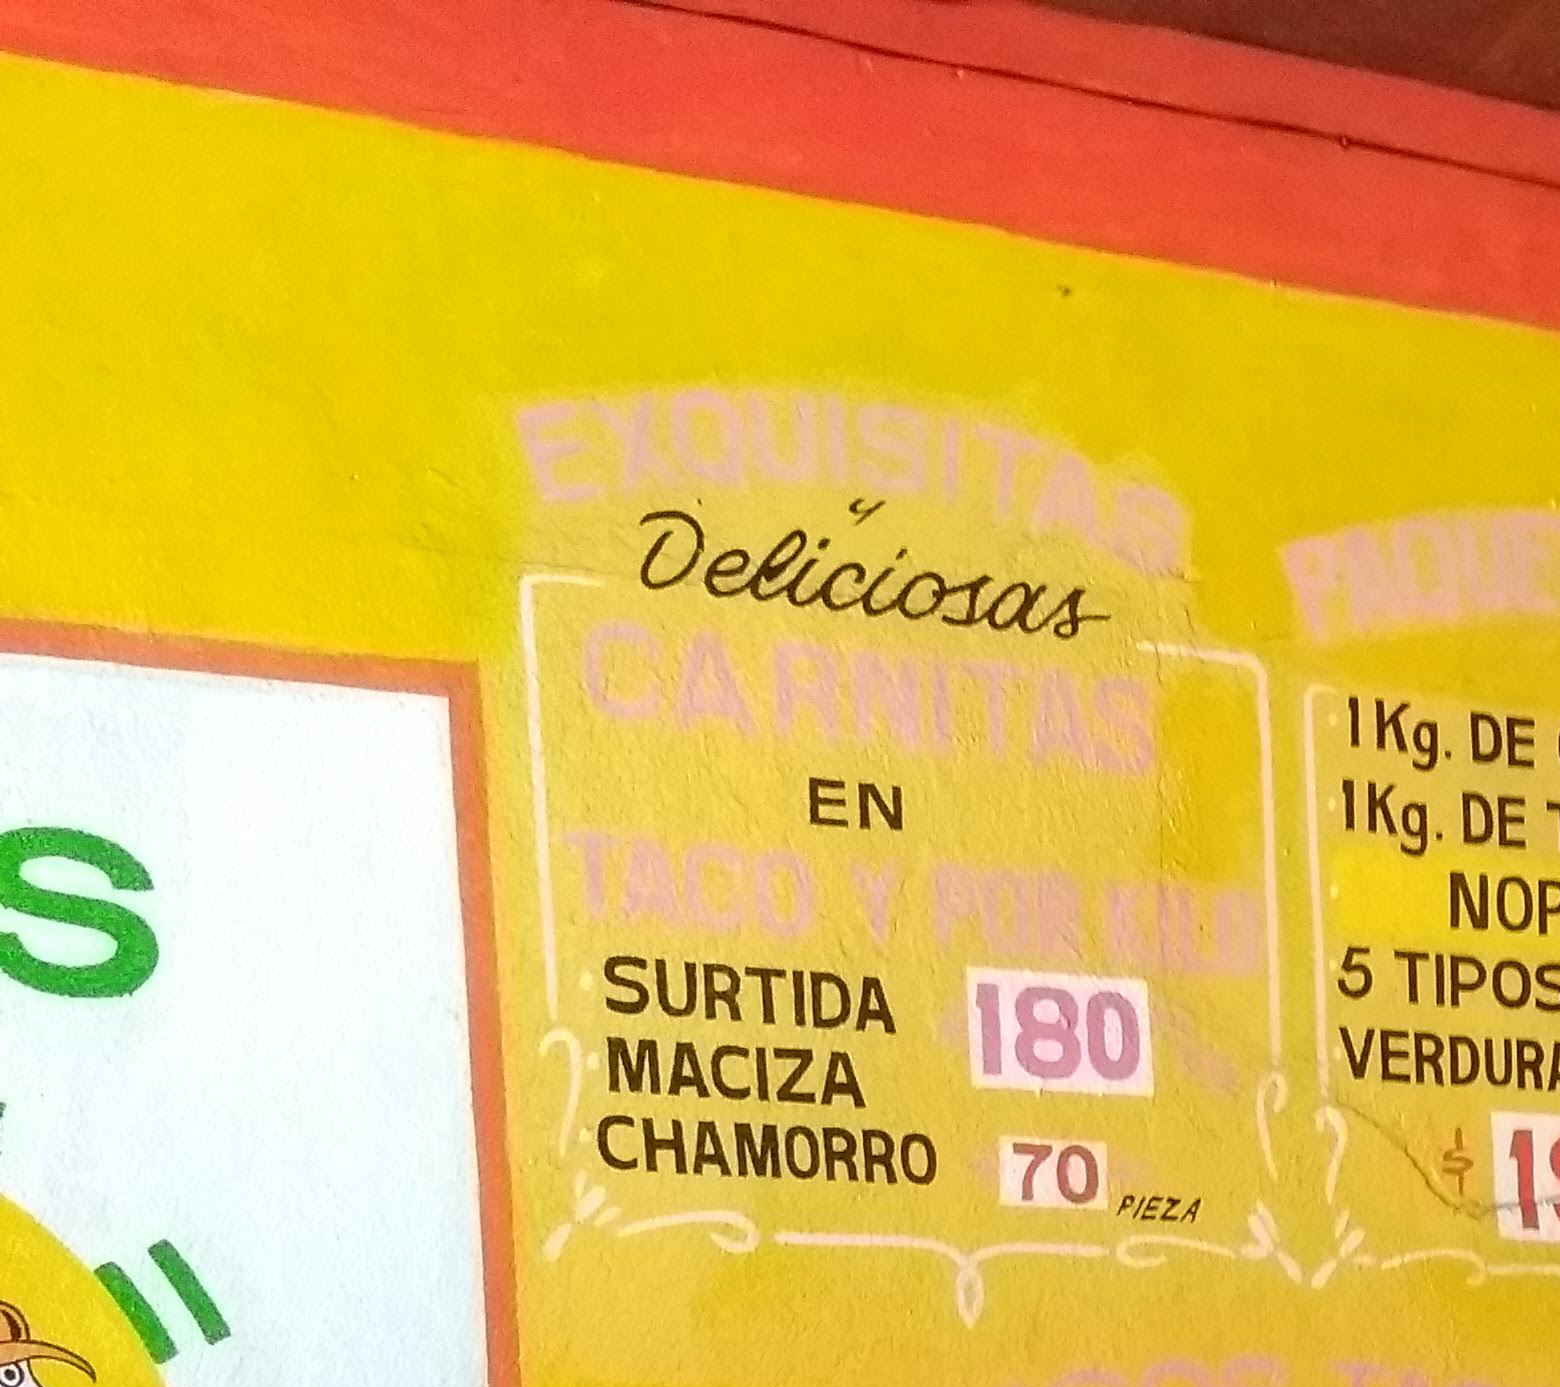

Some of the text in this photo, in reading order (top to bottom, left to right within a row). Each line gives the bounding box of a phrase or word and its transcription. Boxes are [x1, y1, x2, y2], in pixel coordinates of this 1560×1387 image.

[515, 390, 1191, 574] EXQUISITAS
[639, 510, 1111, 640] Deliciosas
[582, 619, 1158, 776] CARNITAS
[1470, 711, 1535, 768] DE
[808, 777, 903, 831] EN
[1461, 791, 1527, 849] DE
[563, 832, 813, 937] TACO
[851, 860, 900, 949] Y
[1104, 881, 1262, 974] KILO
[603, 955, 897, 1035] SURTIDA
[1337, 946, 1373, 1000] 5
[976, 983, 1140, 1081] 180
[606, 1036, 867, 1109] MACIZA
[597, 1115, 937, 1186] CHAMORRO
[1012, 1143, 1202, 1223] 70 PIEZA
